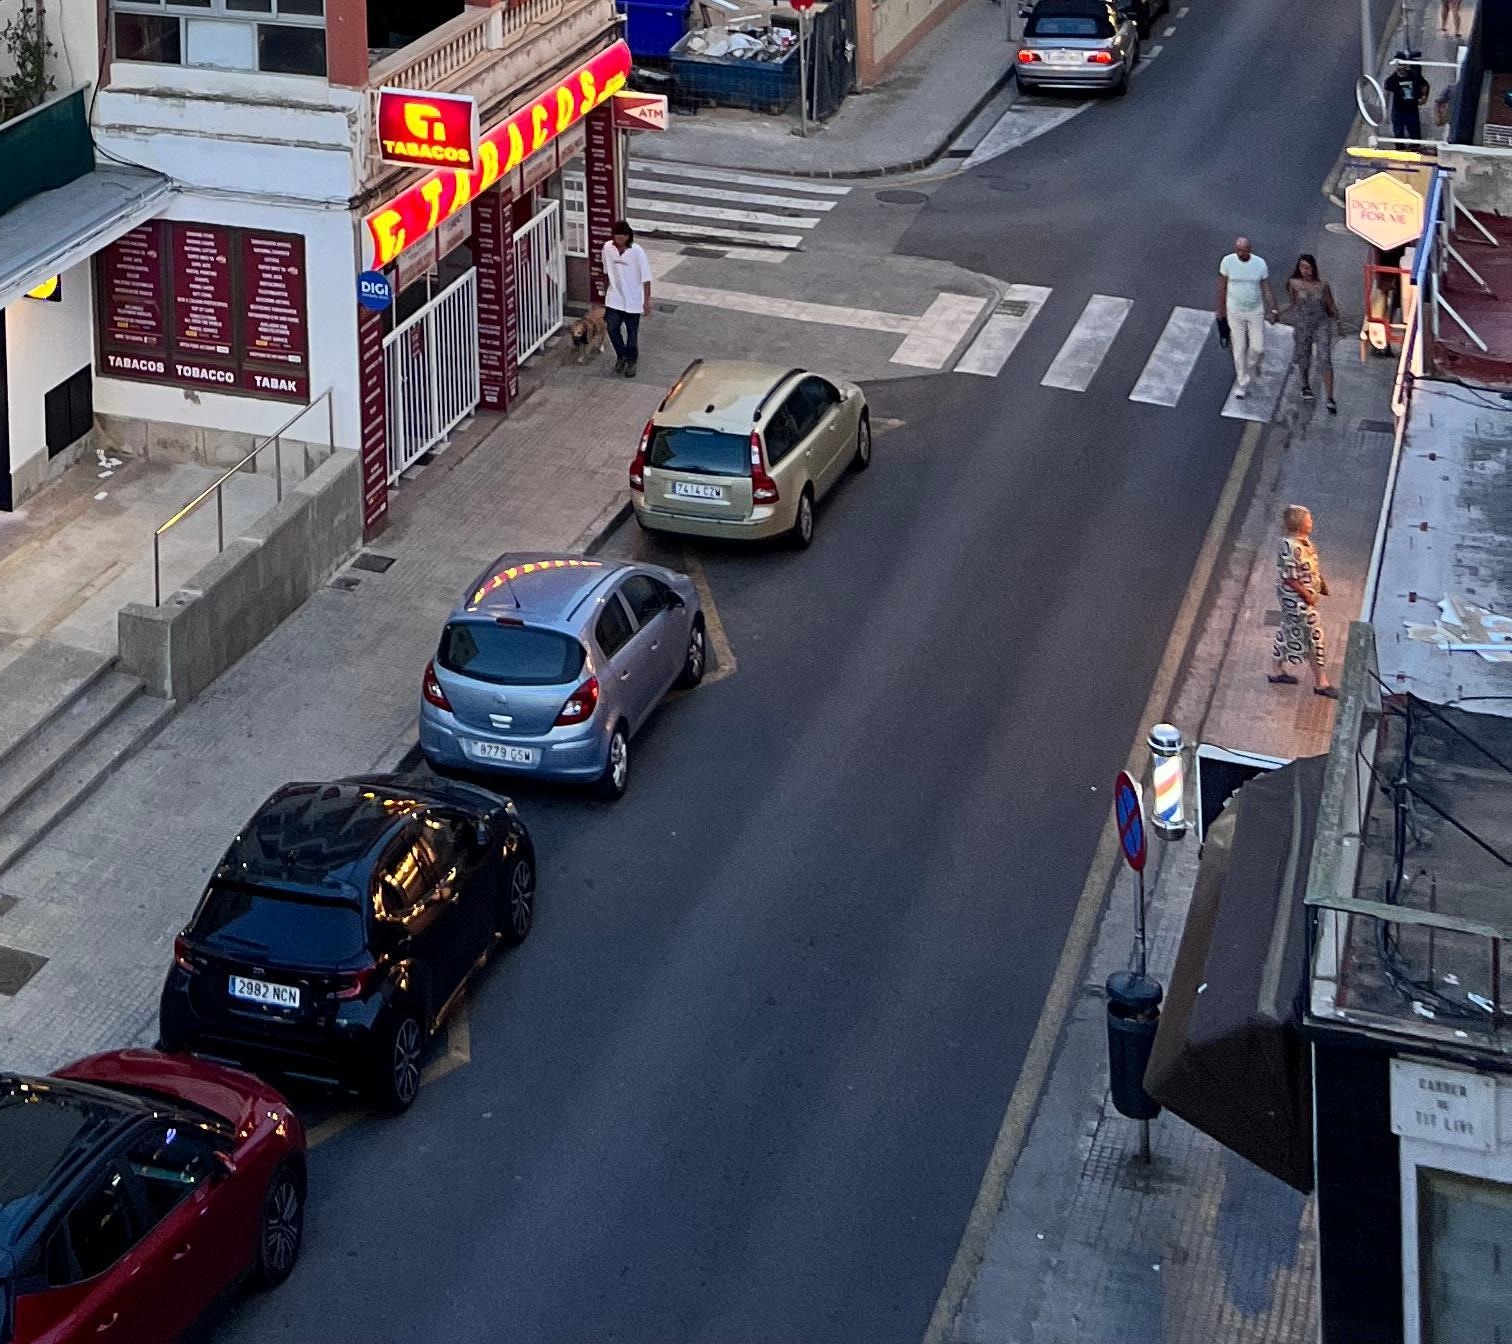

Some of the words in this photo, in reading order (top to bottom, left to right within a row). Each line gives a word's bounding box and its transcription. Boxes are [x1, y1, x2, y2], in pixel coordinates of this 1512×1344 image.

[638, 107, 664, 119] ATM
[382, 140, 470, 163] TABACOS
[421, 69, 598, 230] TABACOS
[361, 281, 389, 297] DIGI
[108, 355, 165, 373] TABACOS
[175, 364, 235, 383] TOBACCO
[254, 375, 297, 392] TABAK
[272, 985, 297, 1004] NCN
